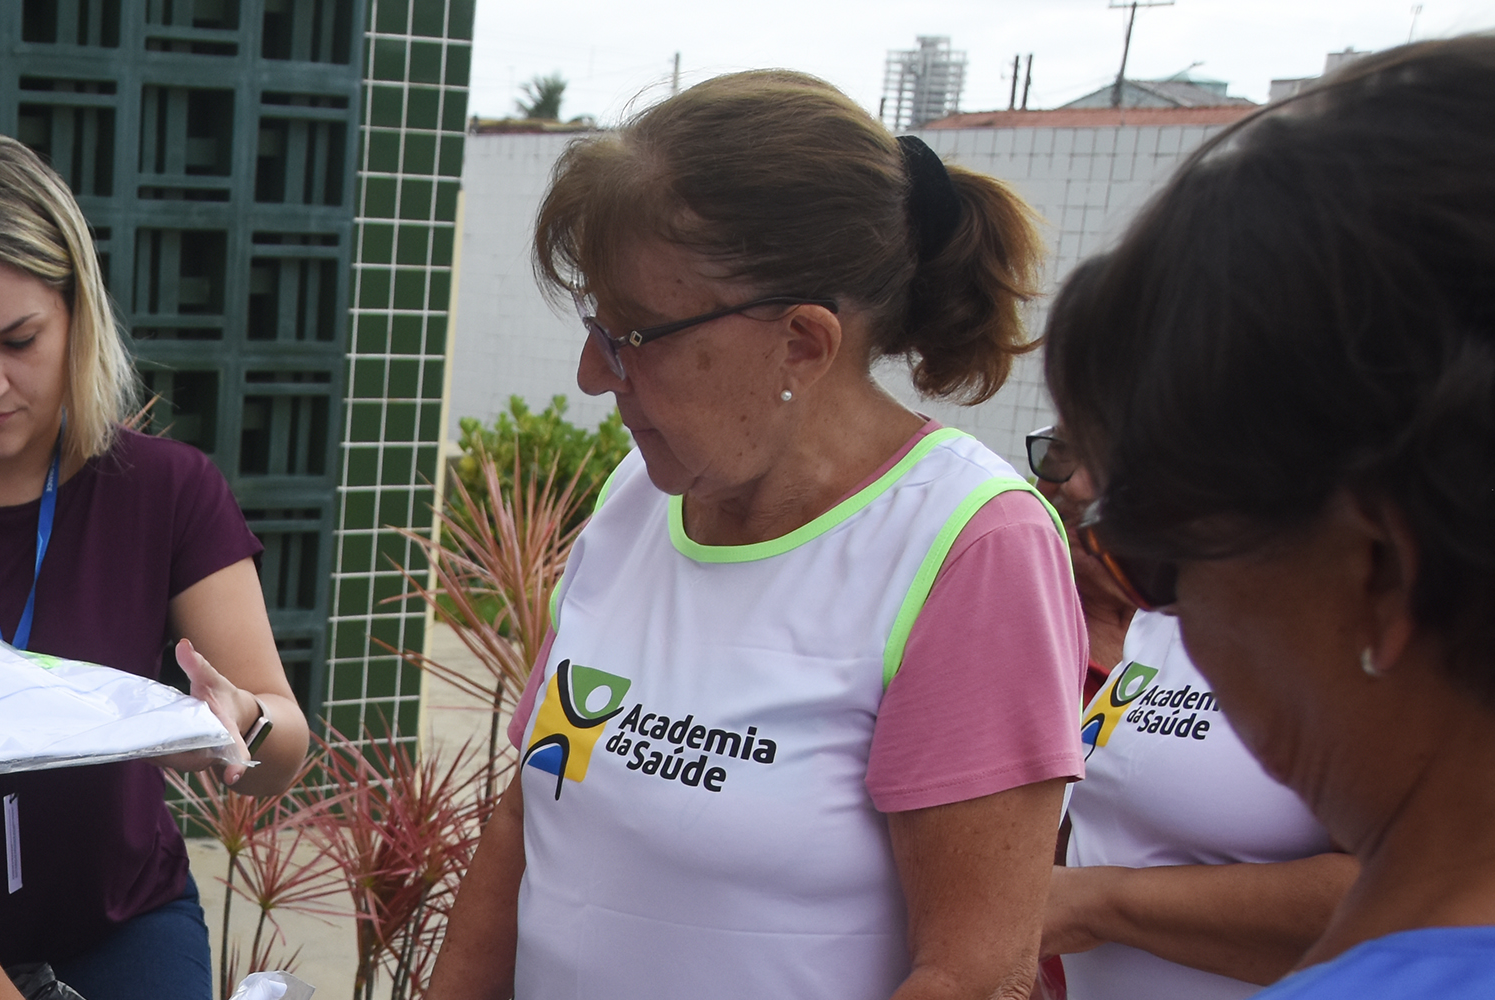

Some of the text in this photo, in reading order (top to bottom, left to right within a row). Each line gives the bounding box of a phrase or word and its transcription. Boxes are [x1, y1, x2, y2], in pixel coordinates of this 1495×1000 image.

[1139, 685, 1219, 711] Academ
[618, 703, 777, 764] Academia
[1127, 707, 1210, 740] da Saúde
[605, 731, 727, 792] da Saúde
